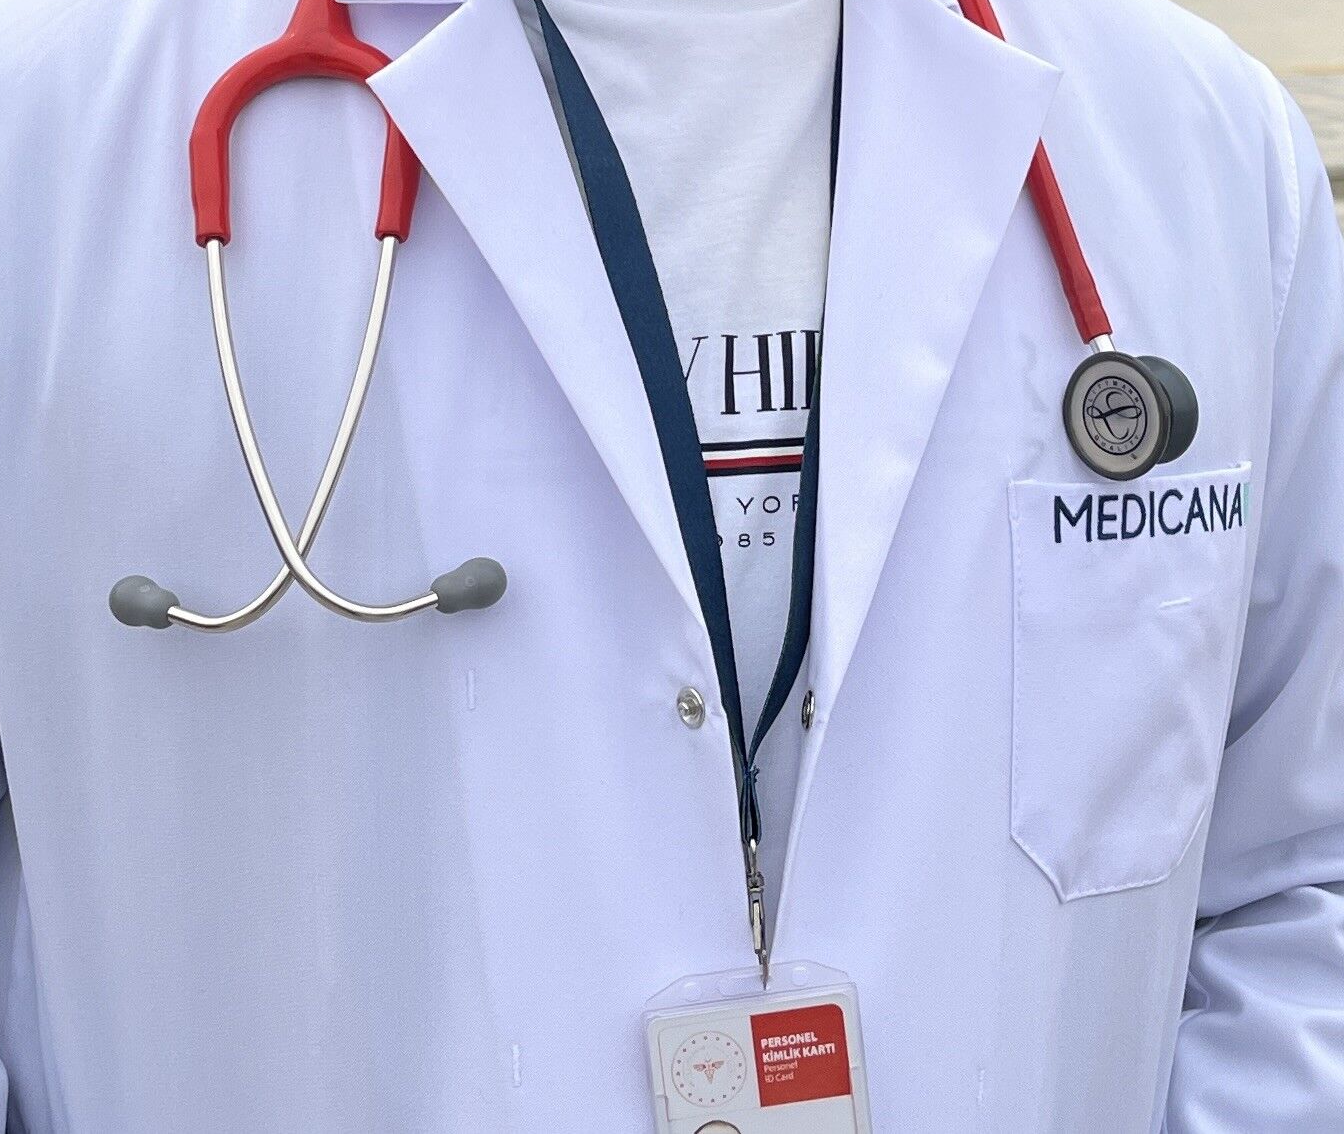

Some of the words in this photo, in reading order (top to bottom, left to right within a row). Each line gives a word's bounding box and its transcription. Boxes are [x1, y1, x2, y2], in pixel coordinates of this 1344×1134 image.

[1053, 482, 1244, 544] MEDICANA
[760, 1031, 818, 1050] PERSONEL
[762, 1047, 802, 1063] KİMLİK
[802, 1042, 836, 1058] KARTI
